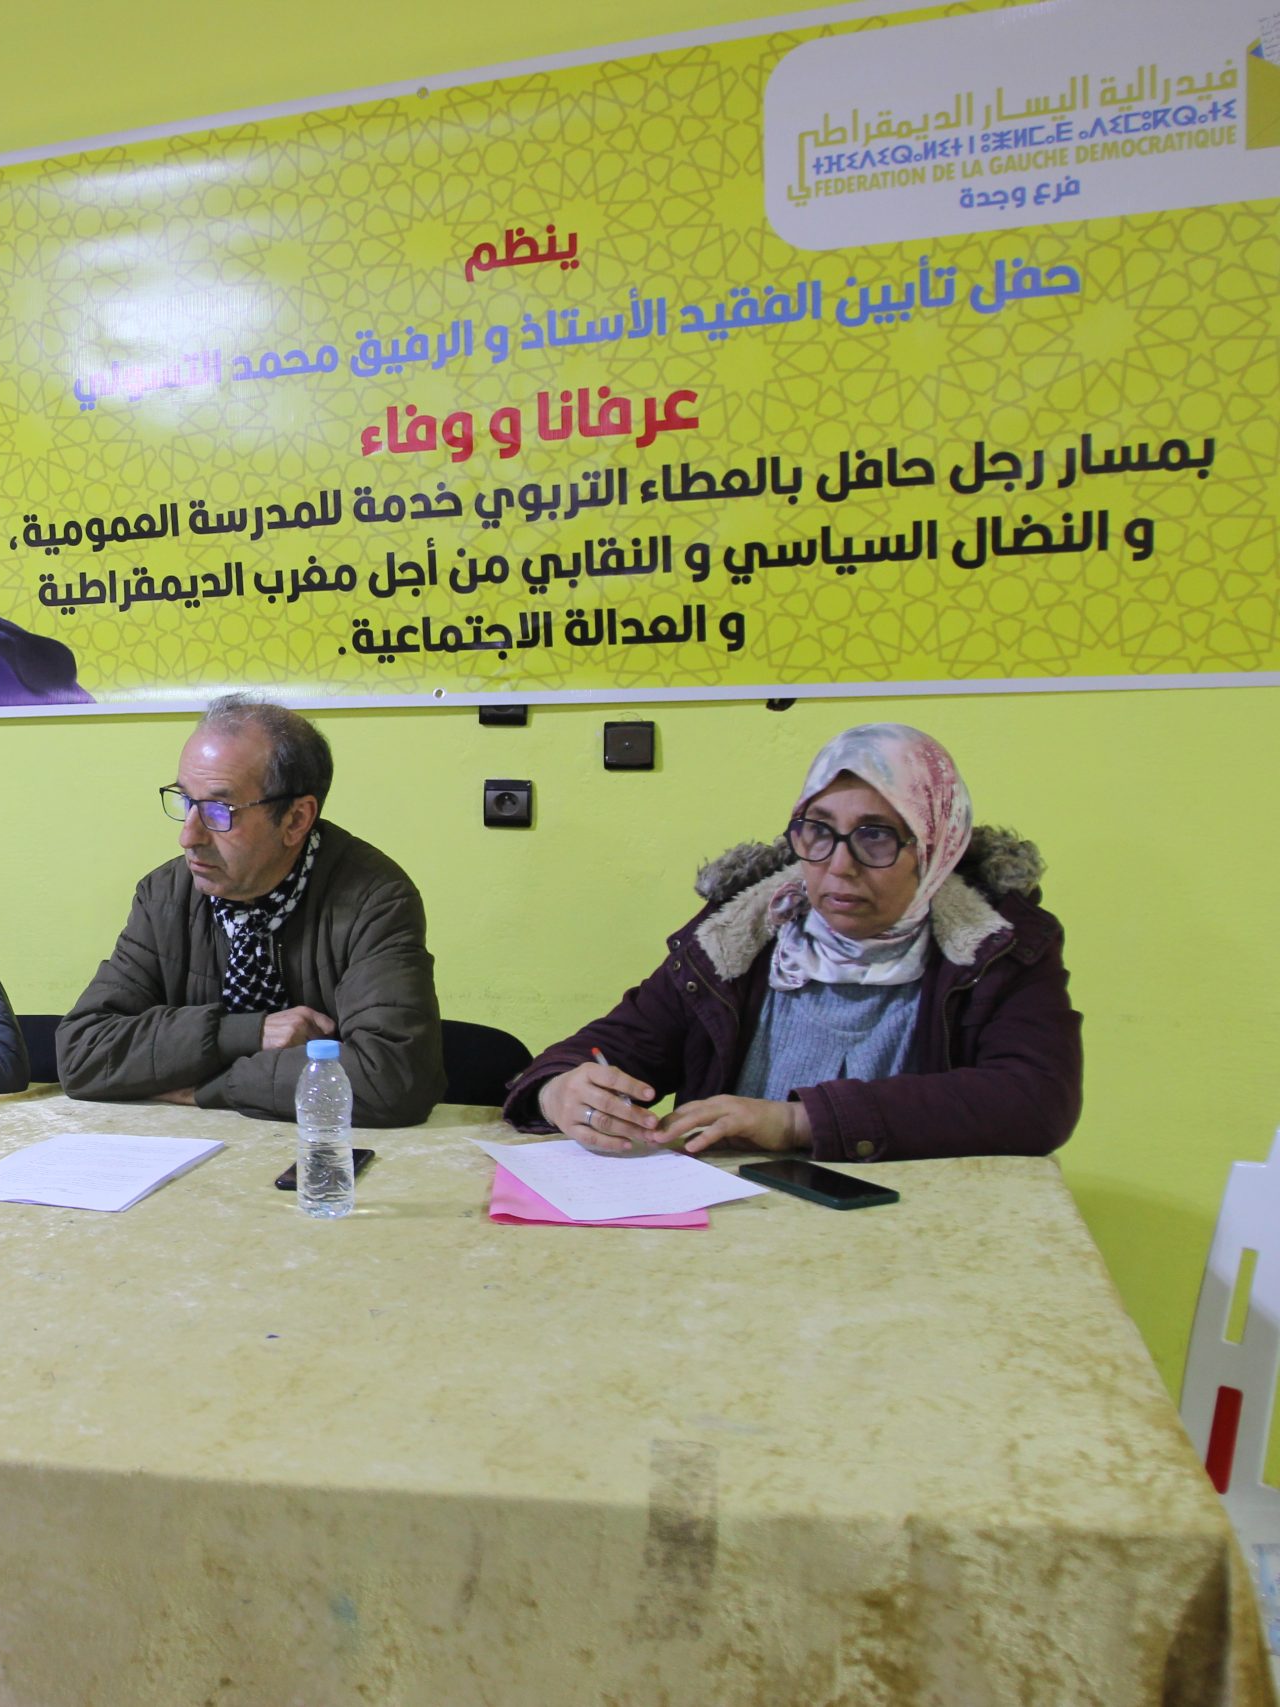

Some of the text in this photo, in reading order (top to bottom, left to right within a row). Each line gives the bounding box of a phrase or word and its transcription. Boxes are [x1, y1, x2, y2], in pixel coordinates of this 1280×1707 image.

[786, 59, 1239, 207] فيدرالية اليسار الديمقراطي
[814, 124, 1237, 198] FEDERATION DE LA GAUCHE DEMOCRATIQUE
[959, 176, 1081, 210] فرع وجدة
[463, 223, 579, 282] ينظم
[678, 280, 822, 343] الفقيد
[835, 254, 958, 328] تأبين
[969, 255, 1082, 315] حفل
[349, 318, 474, 378] الرفيق
[483, 323, 511, 365] و
[522, 288, 667, 351] الأستاذ
[232, 343, 339, 382] محمد
[360, 384, 700, 463] عرفانا و وفاء
[639, 456, 804, 506] بالعطاء
[816, 446, 936, 503] حافل
[949, 440, 1045, 493] رجل
[1059, 432, 1217, 488] بمسار
[188, 489, 343, 541] للمدرسة
[352, 482, 463, 524] خدمة
[474, 468, 628, 530] التربوي
[37, 508, 1155, 616] و النضال السياسي و النقابي من أجل مغرب الديمقراطية
[338, 604, 746, 665] و العدالة الاجتماعية.
